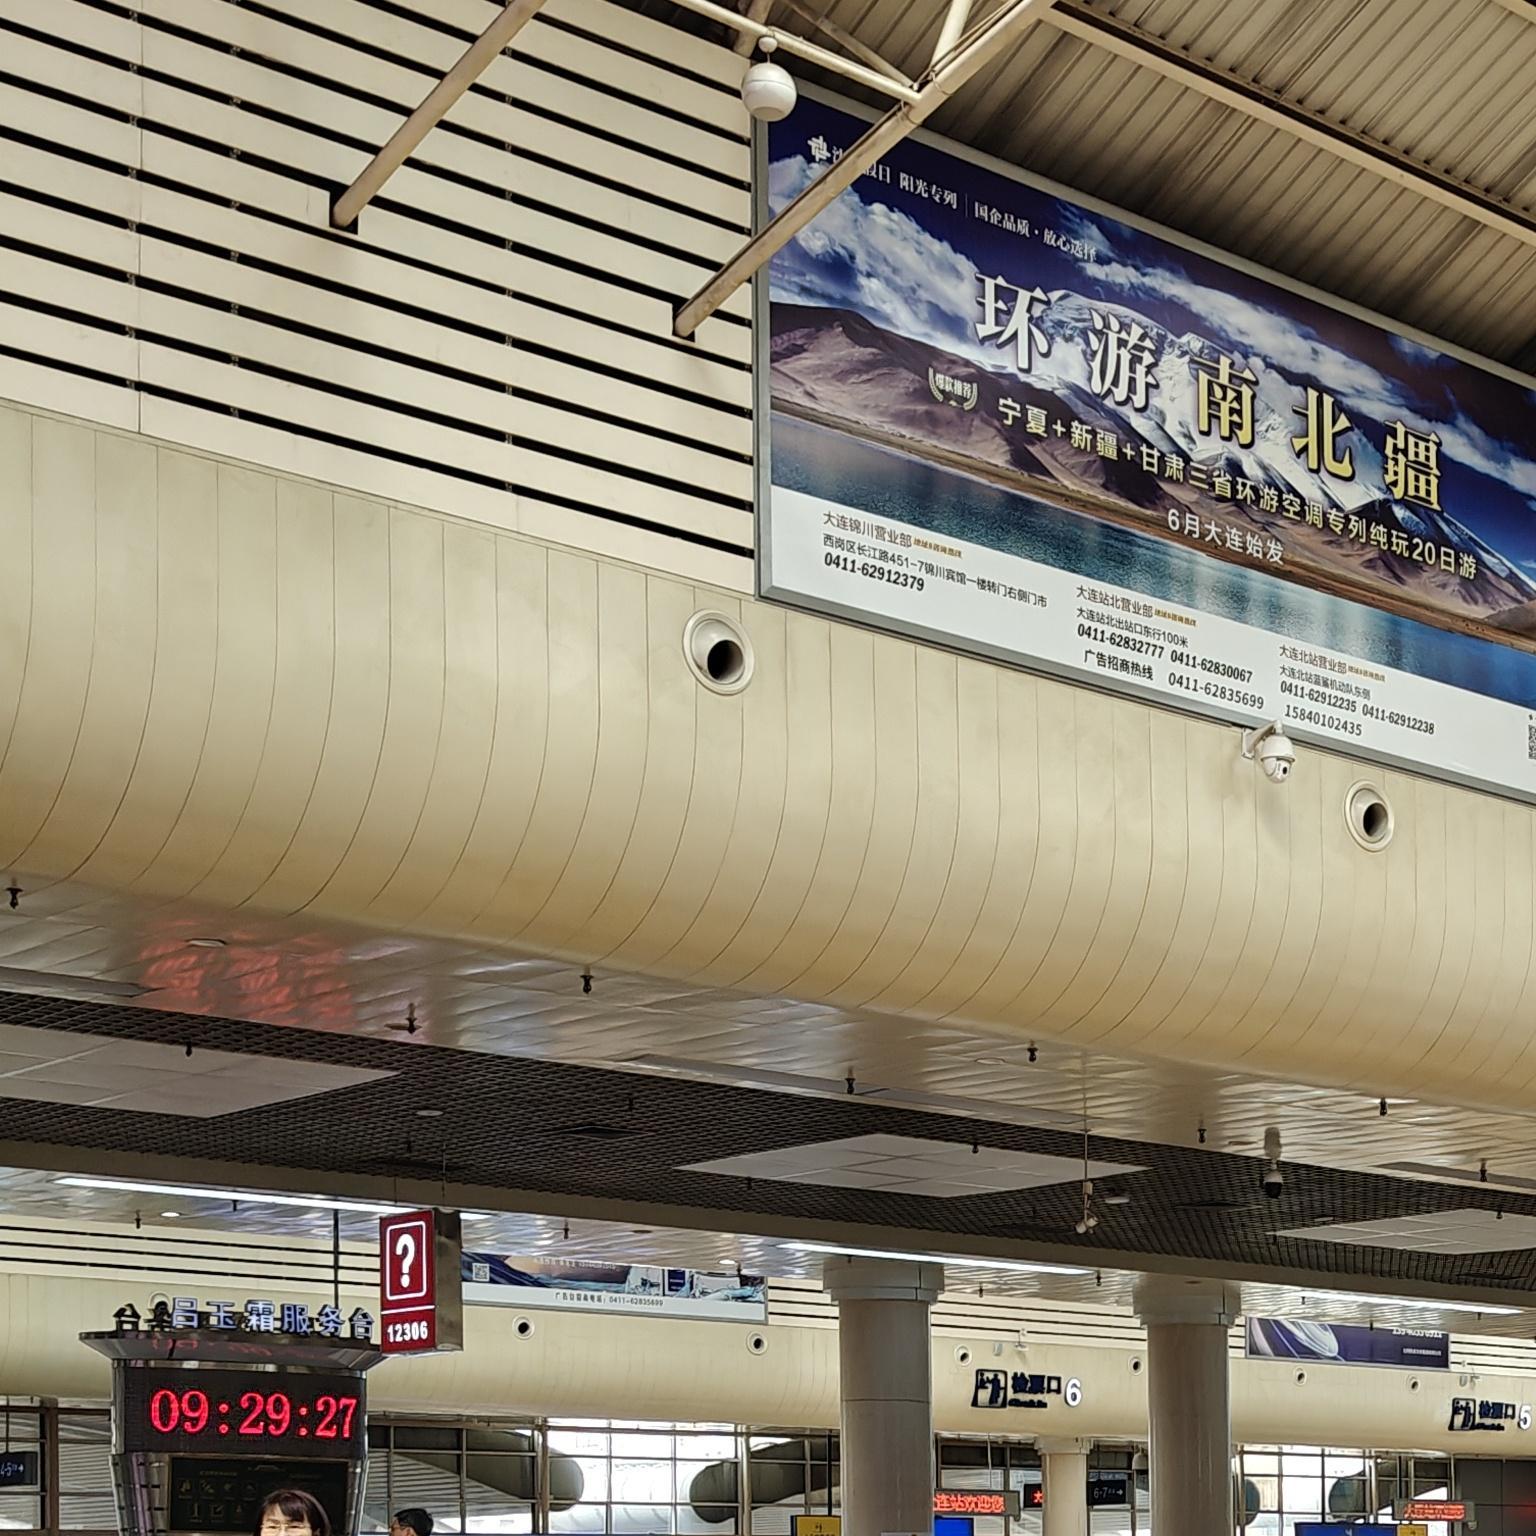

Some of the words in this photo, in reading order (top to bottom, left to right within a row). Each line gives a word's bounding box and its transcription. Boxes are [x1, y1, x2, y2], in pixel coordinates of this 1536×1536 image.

[899, 171, 957, 210] 阳光专列
[974, 272, 1443, 512] 环游南北疆
[998, 397, 1478, 581] 宁夏+新疆+甘肃三省环游空调专列纯玩20日游
[823, 511, 913, 548] 大连锦川营业部
[1167, 508, 1285, 566] 6月大连始发
[823, 532, 1048, 608] 西岗区长江路451-7锦川宾馆一楼转门右侧门市
[824, 551, 925, 592] 0411-62912379
[1076, 585, 1153, 619] 大连站北营业部
[1076, 607, 1189, 648] 大连站北出站口东行100米
[1077, 622, 1165, 659] 0411-62832777
[1170, 648, 1253, 684] 0411-62830067
[1279, 644, 1347, 675] 大连北站营业部
[1084, 648, 1154, 681] 广告招商热线
[1168, 671, 1264, 710] 0411-62835699
[1280, 680, 1357, 713] 0411-62912235
[1361, 702, 1435, 736] 0411-62912238
[1284, 704, 1363, 737] 15840102435
[171, 1297, 375, 1340] 吕玉霜服务台
[387, 1320, 428, 1343] 12306
[1064, 1377, 1082, 1407] 6
[151, 1388, 357, 1440] 09:29:27
[1518, 1404, 1532, 1431] 5
